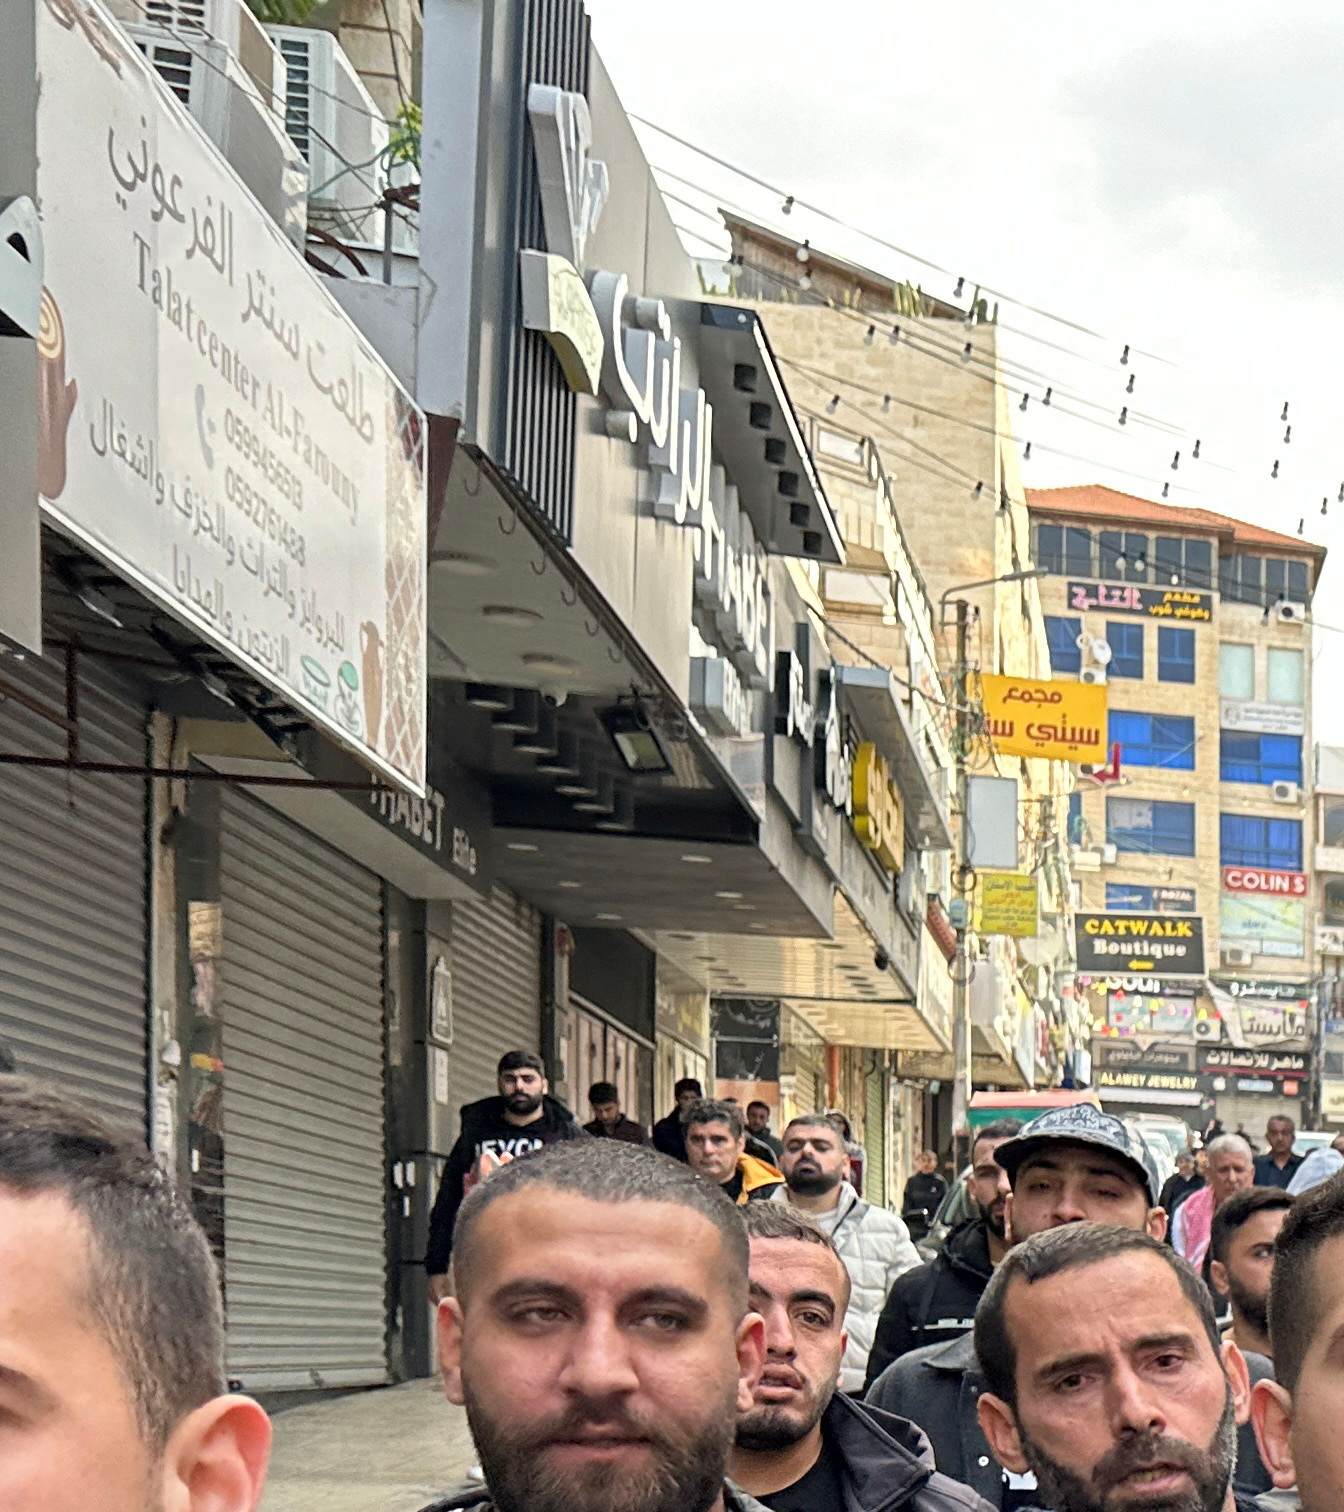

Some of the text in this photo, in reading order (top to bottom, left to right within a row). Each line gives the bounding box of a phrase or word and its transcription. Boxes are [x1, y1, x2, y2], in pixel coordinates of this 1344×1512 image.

[107, 113, 375, 445] طلعت سنتر الفرعوني
[132, 230, 194, 344] Talat
[198, 318, 262, 413] center
[1002, 686, 1063, 709] مجمع
[1084, 918, 1194, 938] CATWALK
[1093, 938, 1187, 960] Boutique
[1205, 1050, 1305, 1071] ماهر للاتصالات
[1146, 1074, 1198, 1090] JEWELRY
